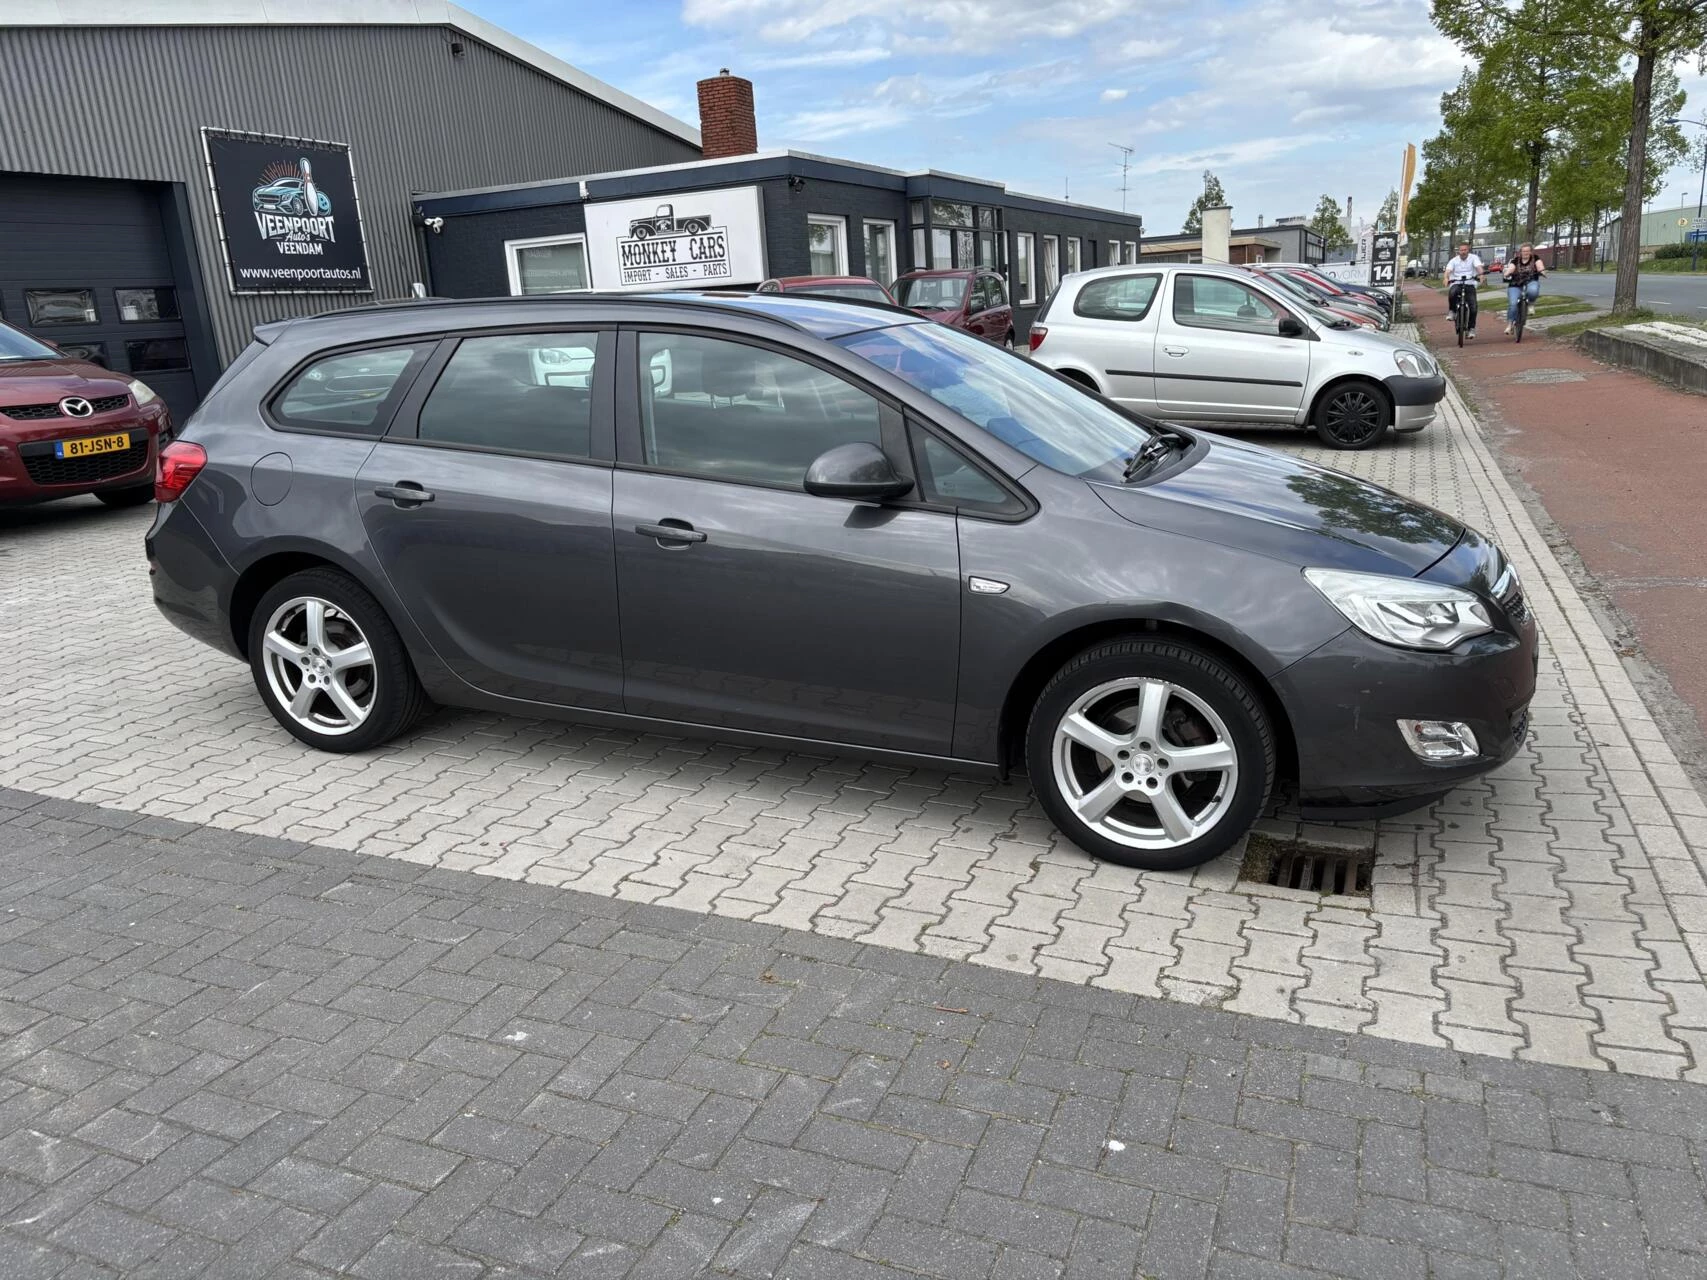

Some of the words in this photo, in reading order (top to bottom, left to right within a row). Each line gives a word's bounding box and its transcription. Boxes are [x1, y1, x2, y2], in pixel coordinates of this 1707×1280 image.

[254, 211, 336, 243] VEENPOORT
[285, 231, 311, 242] Auto's
[276, 241, 324, 255] VEENDAM
[621, 240, 677, 267] MONKEY
[689, 235, 726, 260] CARS
[240, 266, 362, 281] www.veenpoortautos.nl
[624, 269, 652, 283] IMPORT
[666, 266, 688, 279] SALES
[703, 262, 728, 276] PARTS
[1373, 265, 1393, 281] 14
[70, 436, 124, 455] 81-JSN-8
